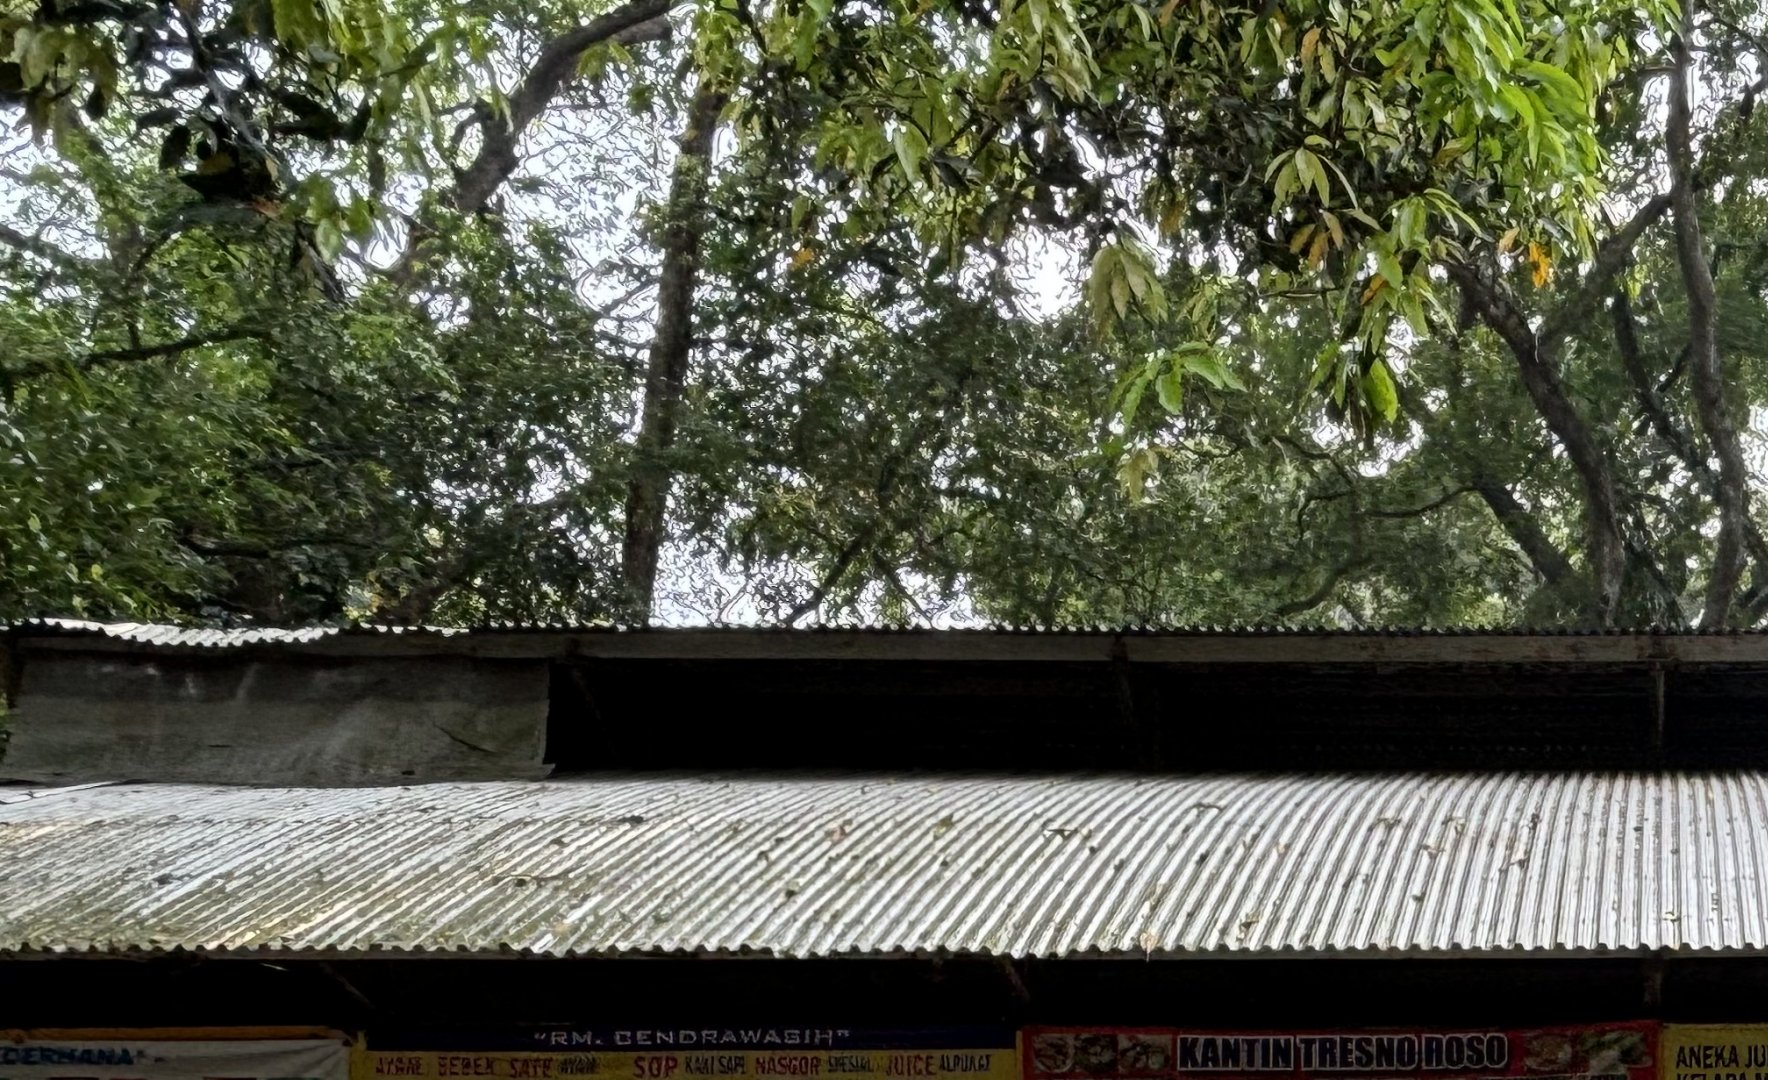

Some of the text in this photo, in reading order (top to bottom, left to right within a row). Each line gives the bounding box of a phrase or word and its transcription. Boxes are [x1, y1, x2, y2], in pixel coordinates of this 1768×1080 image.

[1179, 1034, 1508, 1069] KANTIN TRESNO ROSO
[1676, 1045, 1739, 1068] ANEKA
[633, 1056, 678, 1078] SOP
[755, 1055, 820, 1076] NASGOR
[885, 1055, 935, 1076] JUICE
